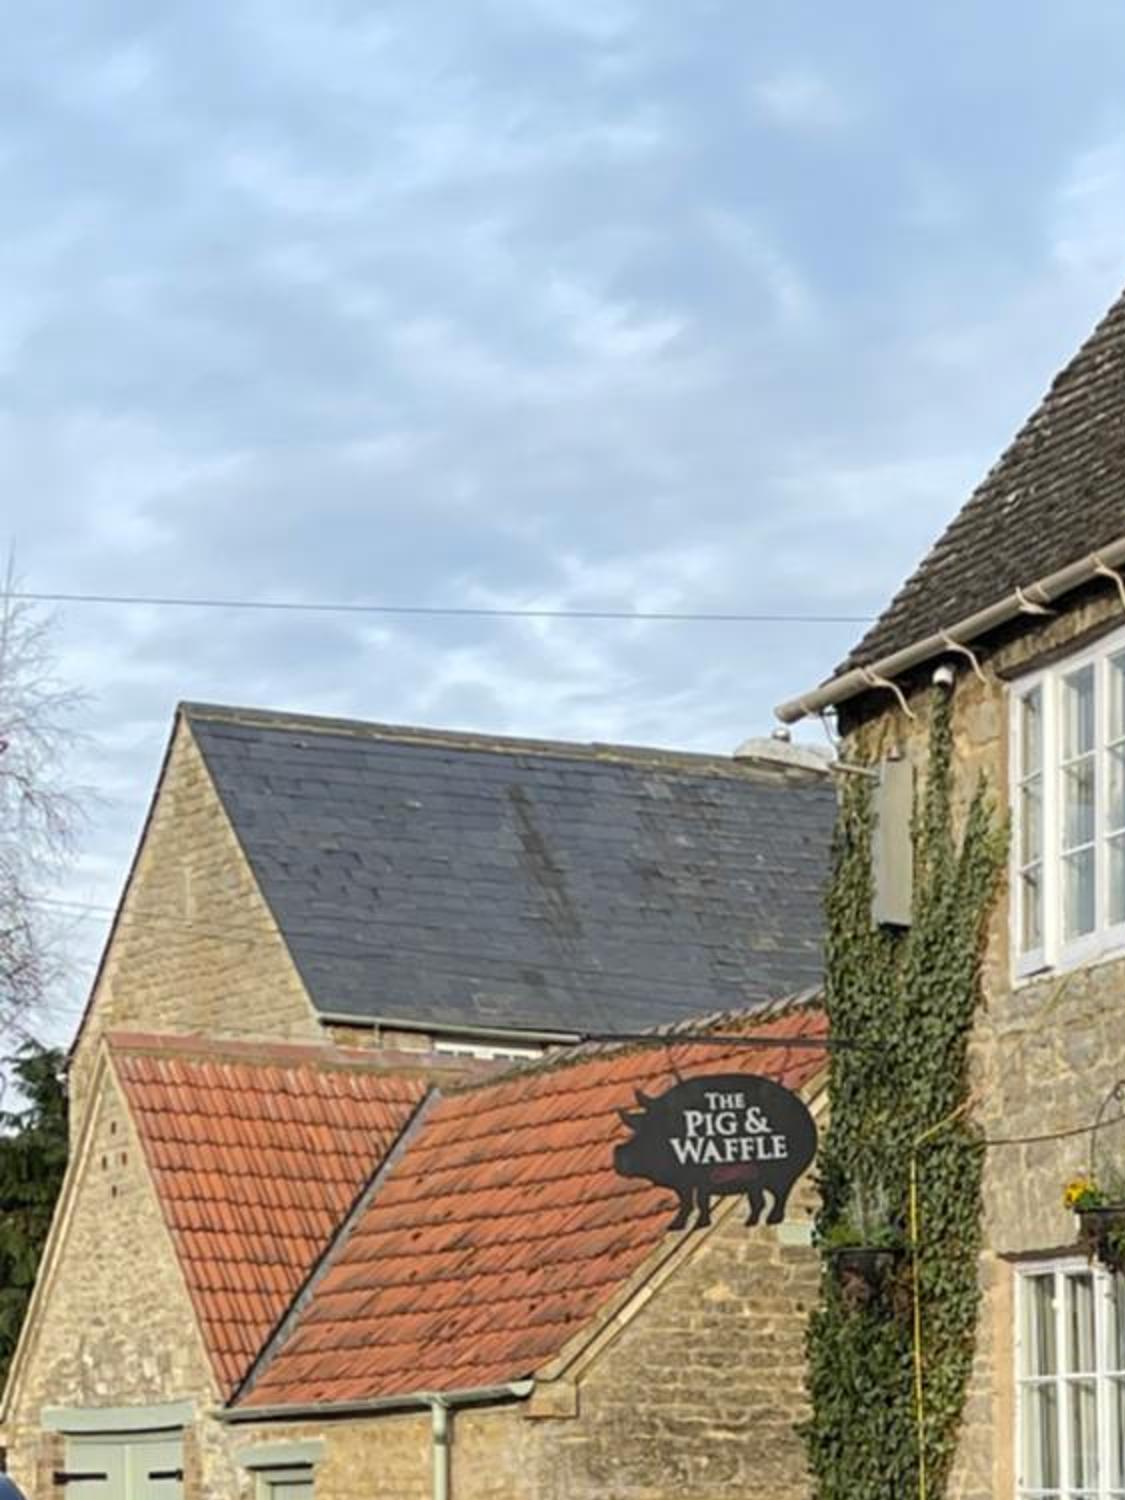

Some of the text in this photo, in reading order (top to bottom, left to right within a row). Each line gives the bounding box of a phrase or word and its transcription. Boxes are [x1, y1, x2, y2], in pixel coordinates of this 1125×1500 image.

[704, 1091, 745, 1110] THE
[683, 1107, 772, 1137] PIG &
[670, 1135, 788, 1165] WAFFLE
